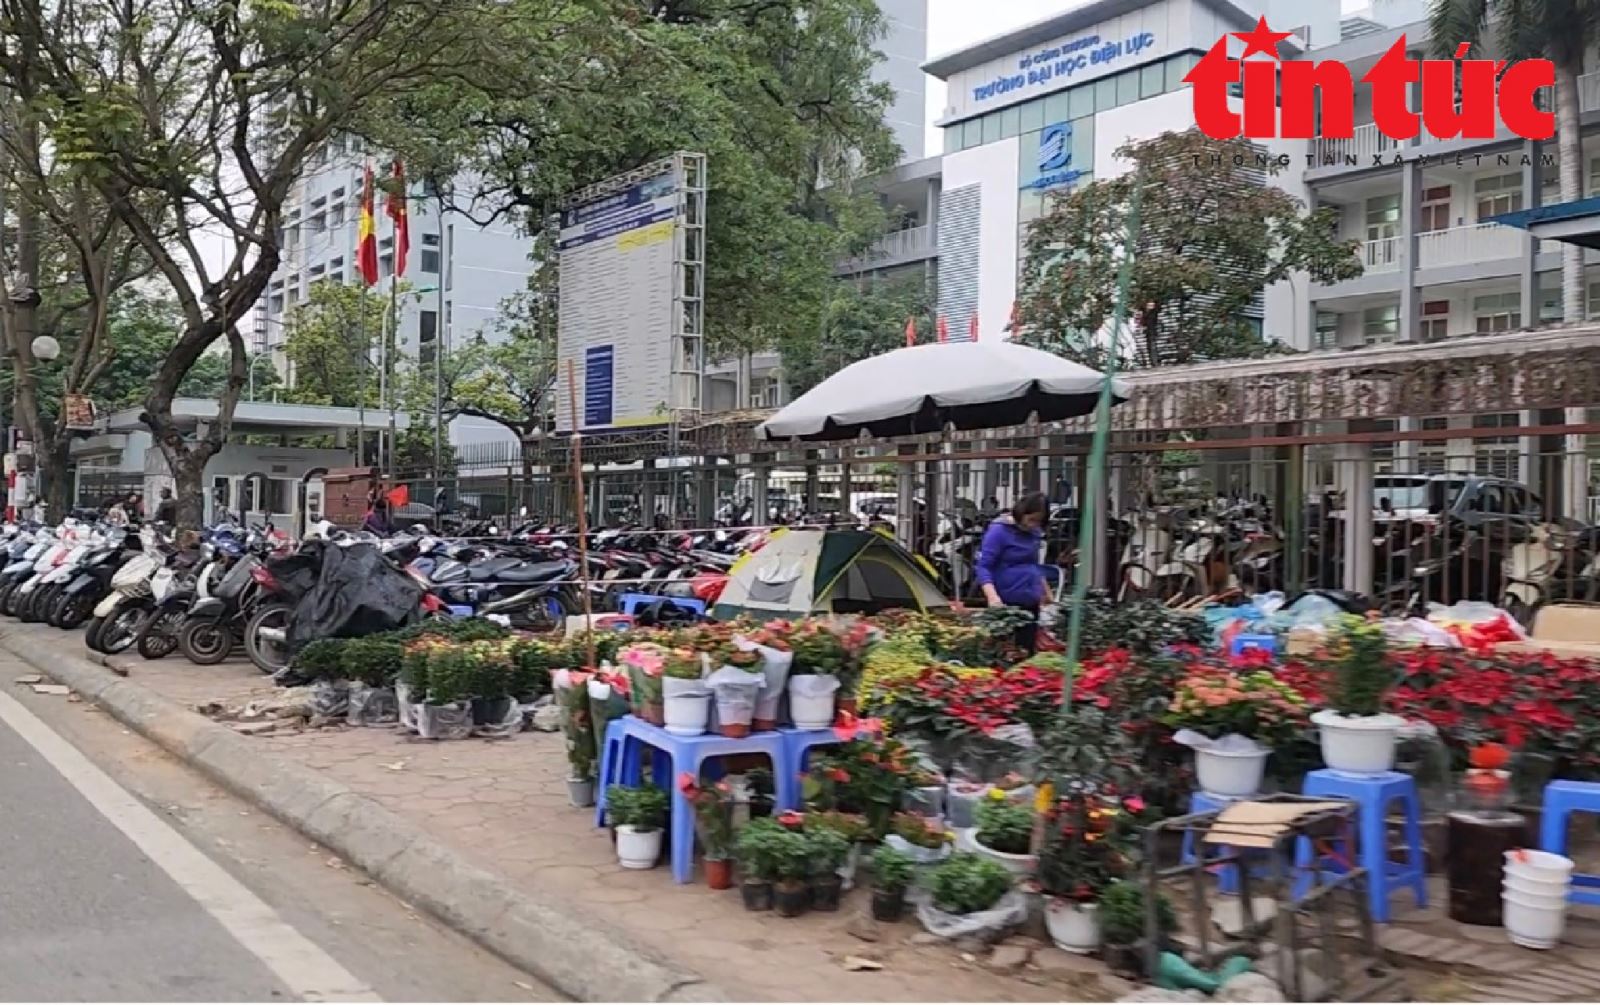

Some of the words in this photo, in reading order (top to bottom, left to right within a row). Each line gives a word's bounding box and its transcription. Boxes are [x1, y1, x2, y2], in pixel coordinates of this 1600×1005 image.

[973, 73, 1025, 102] TRƯỜNG
[1028, 64, 1051, 85] ĐẠI
[1055, 54, 1087, 77] HỌC
[1090, 40, 1122, 65] ĐIỆN
[1126, 32, 1155, 55] LỰC
